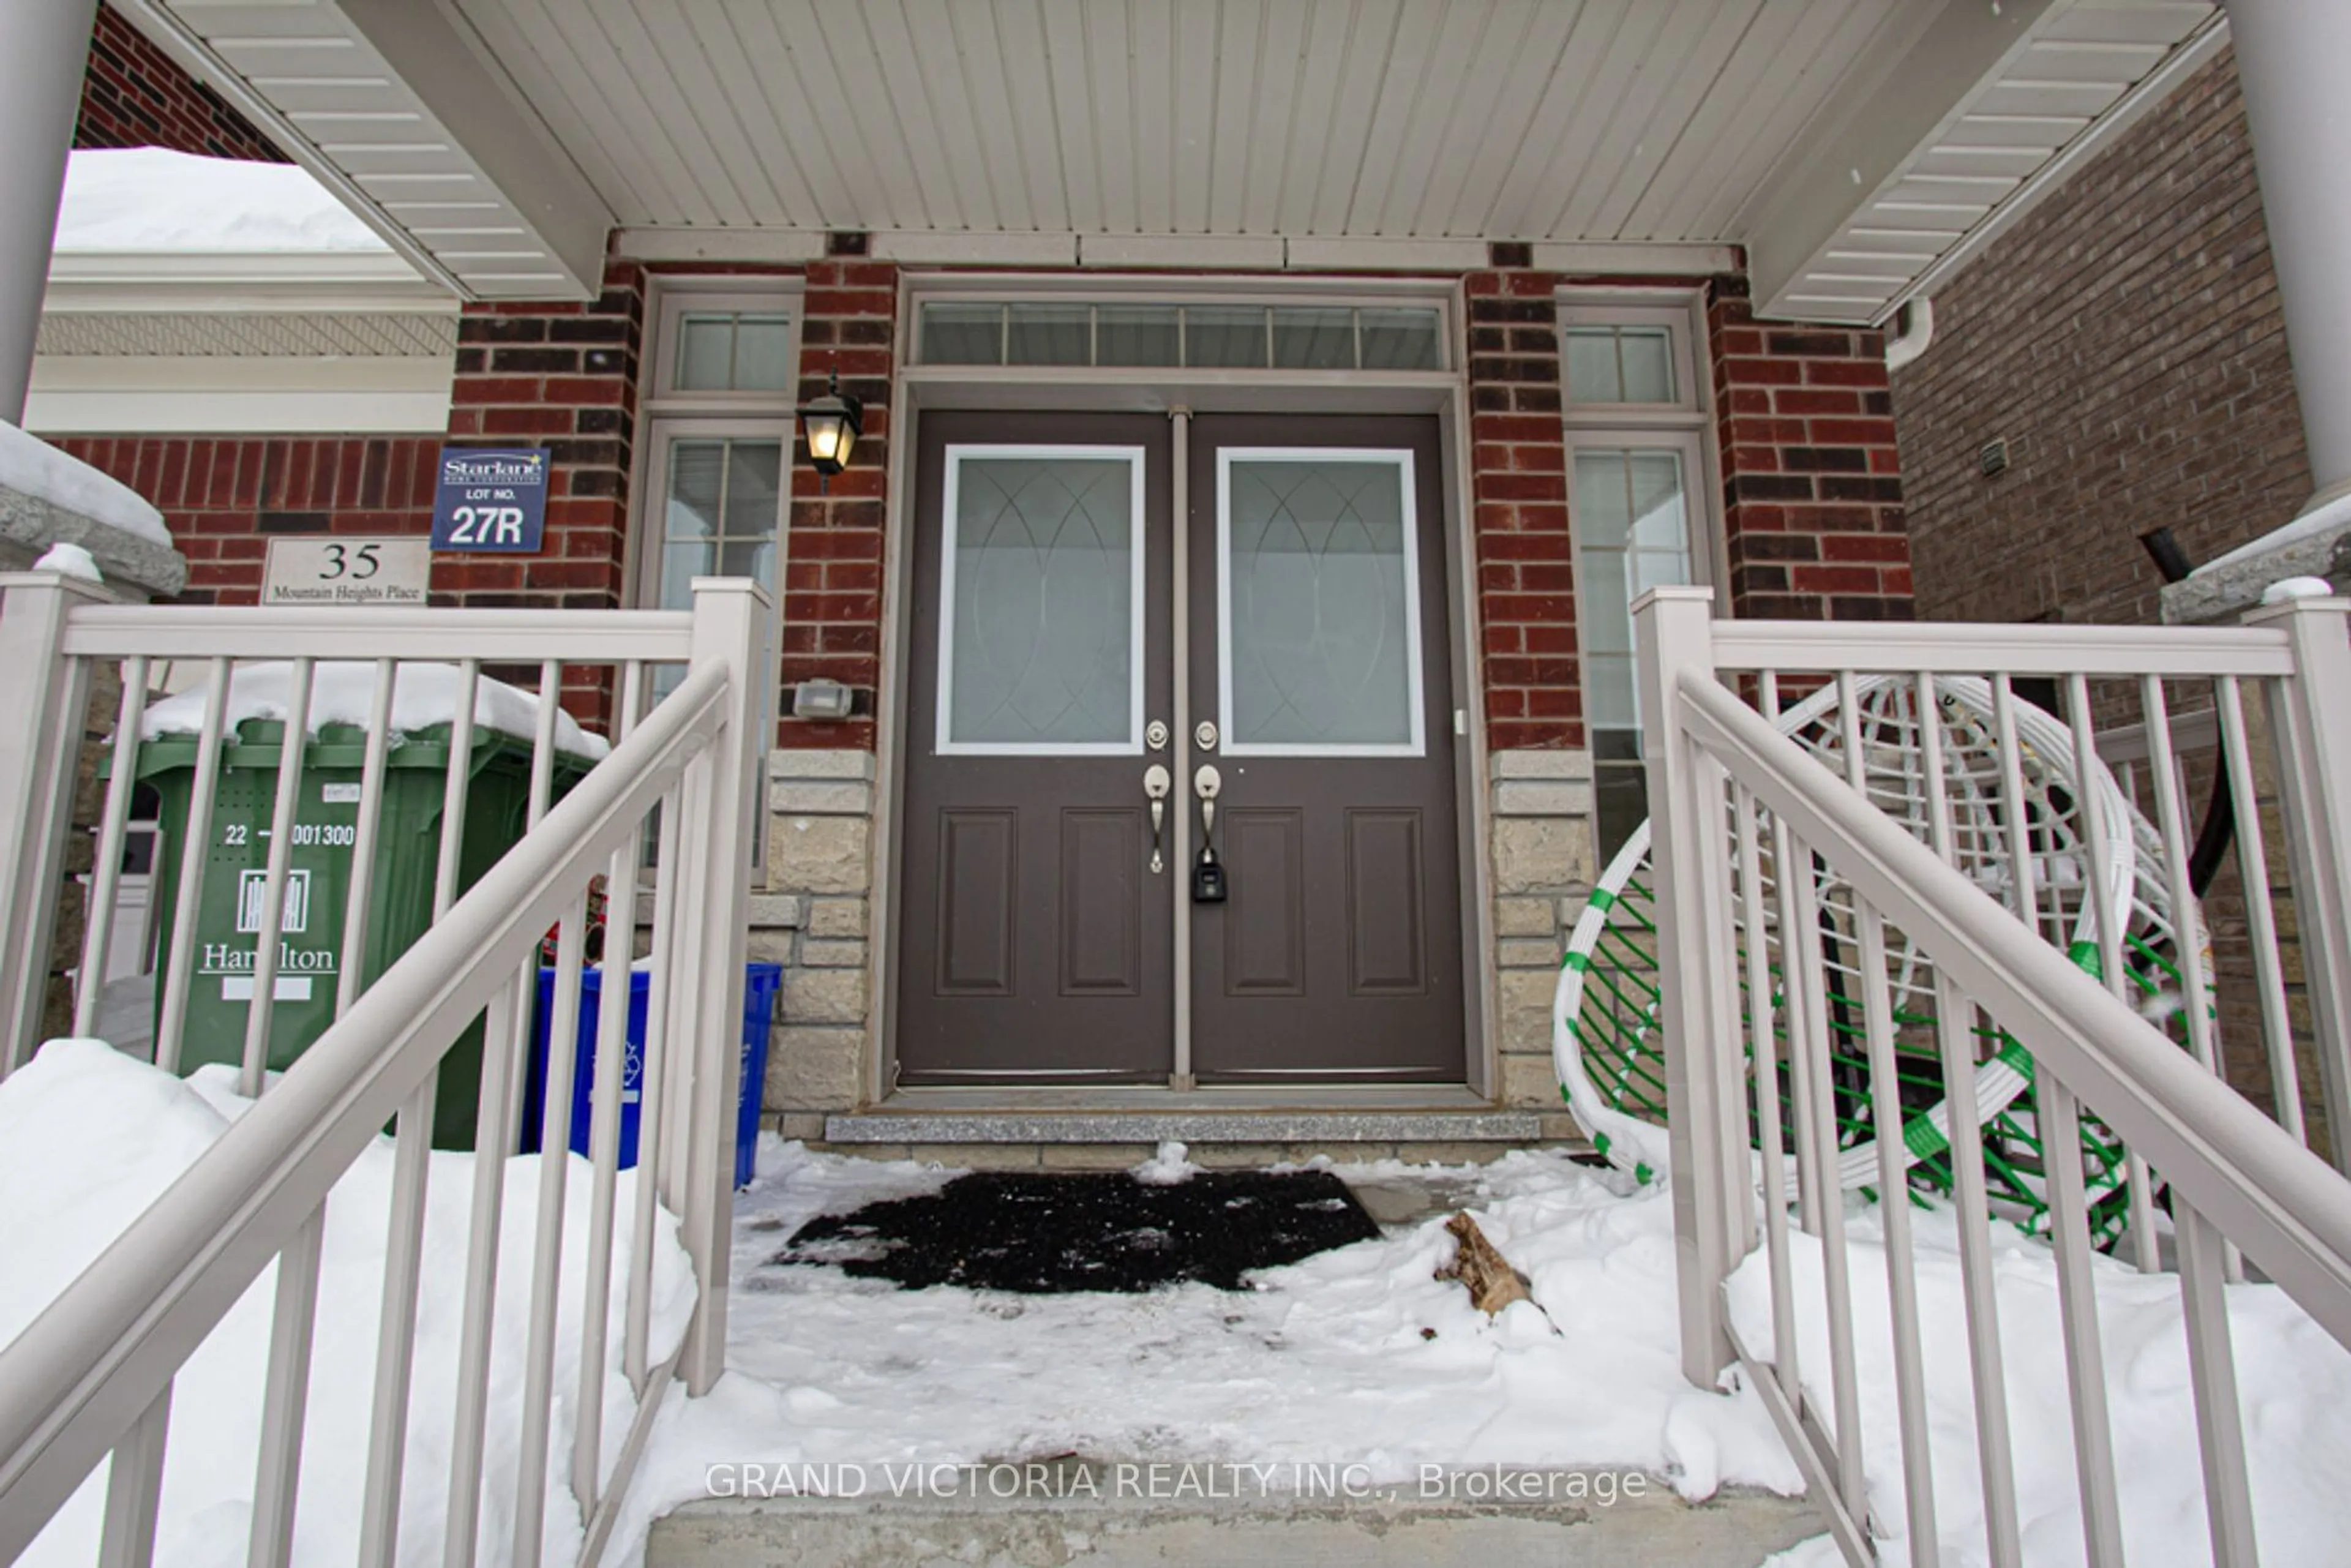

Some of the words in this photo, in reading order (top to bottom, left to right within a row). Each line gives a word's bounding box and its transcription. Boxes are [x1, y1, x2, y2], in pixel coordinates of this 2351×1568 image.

[466, 489, 490, 500] LOT
[493, 489, 516, 500] NO.
[449, 506, 523, 544] 27R
[319, 544, 381, 580] 35
[275, 585, 332, 599] Mountain
[336, 585, 383, 603] Heights
[386, 585, 420, 599] Place
[225, 825, 247, 845] 22
[291, 825, 354, 846] 001300
